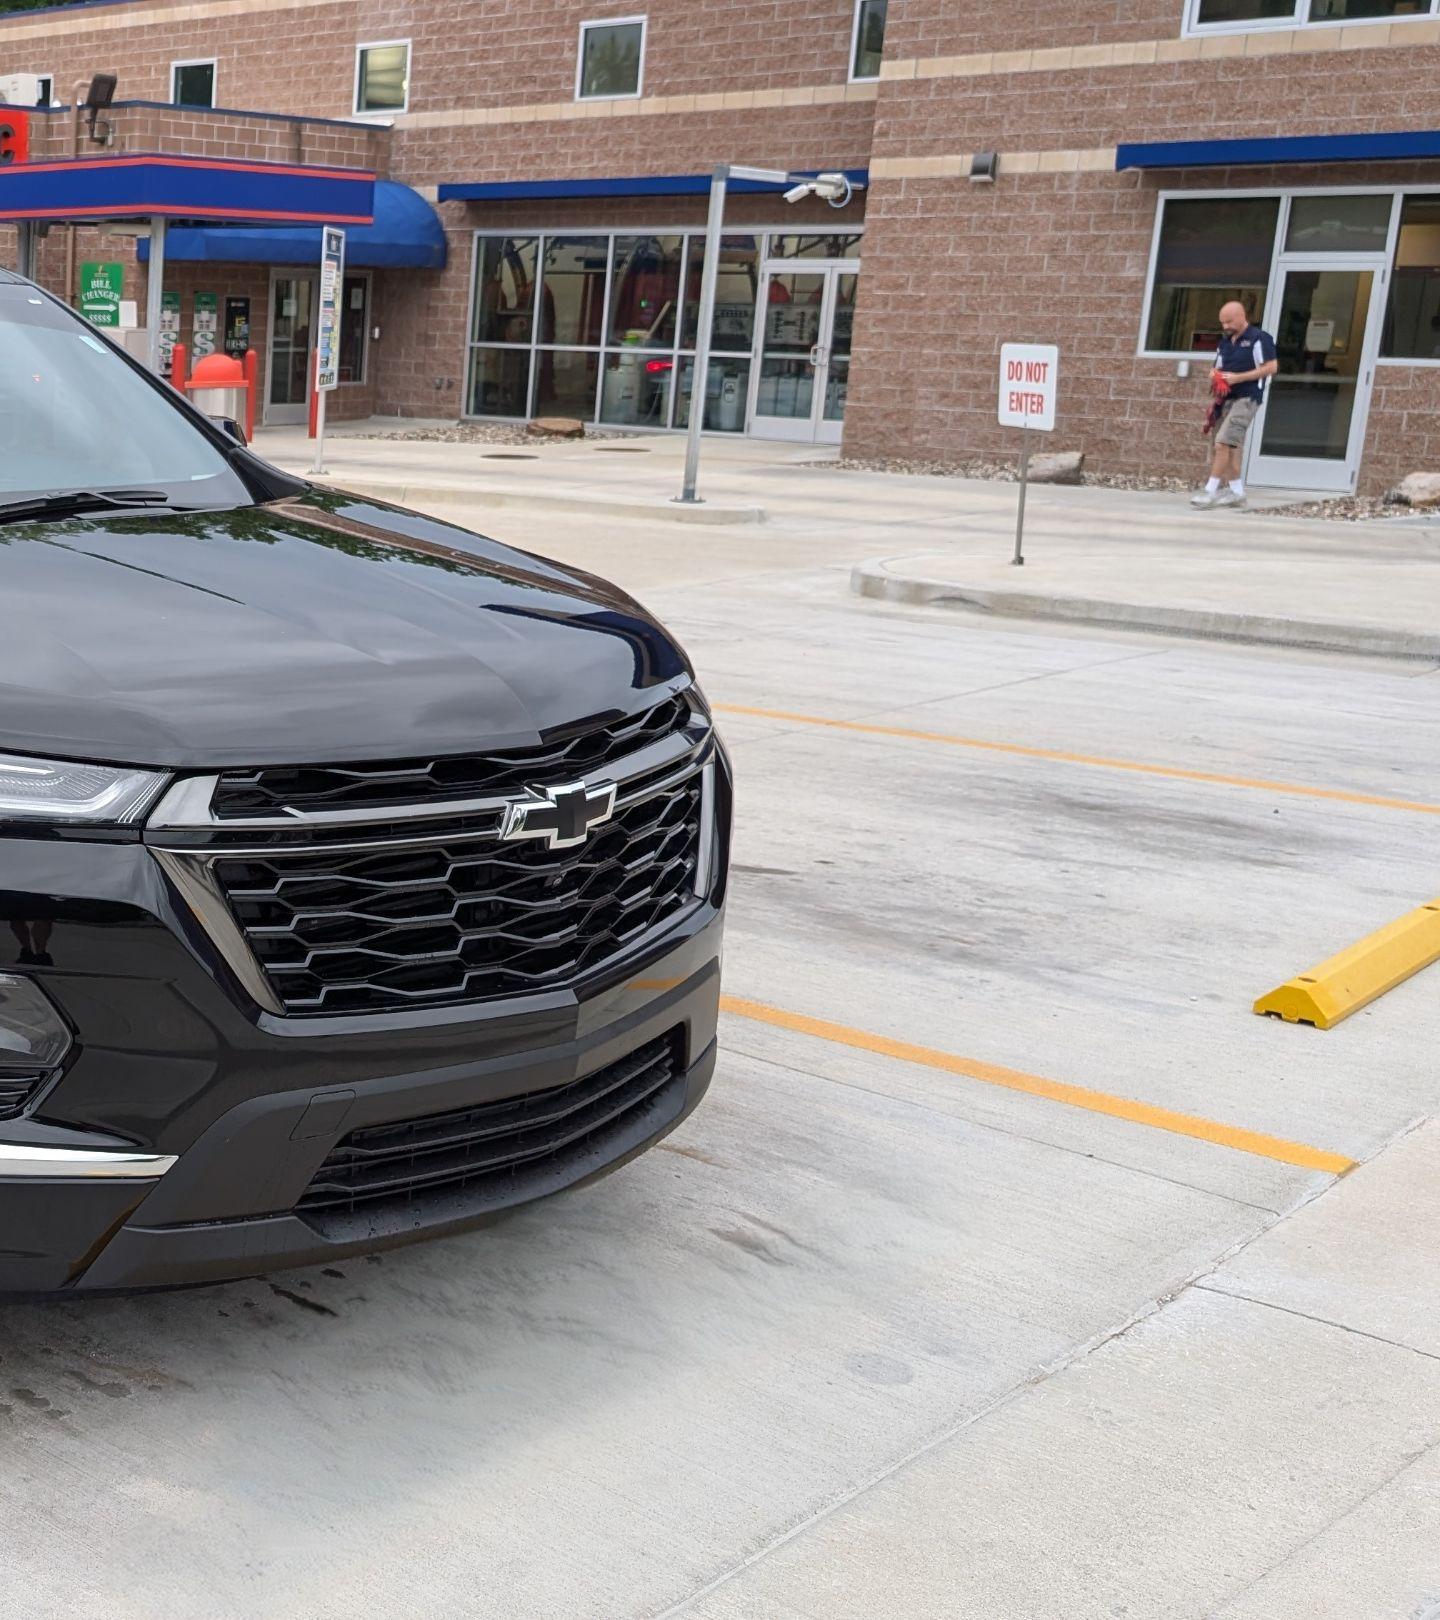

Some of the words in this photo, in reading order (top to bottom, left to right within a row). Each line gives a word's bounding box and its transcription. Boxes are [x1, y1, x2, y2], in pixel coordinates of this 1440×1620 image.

[90, 279, 112, 290] BILL
[81, 289, 120, 303] CHANGER
[1007, 360, 1023, 381] DO
[1025, 361, 1049, 384] NOT
[1008, 391, 1045, 415] ENTER
